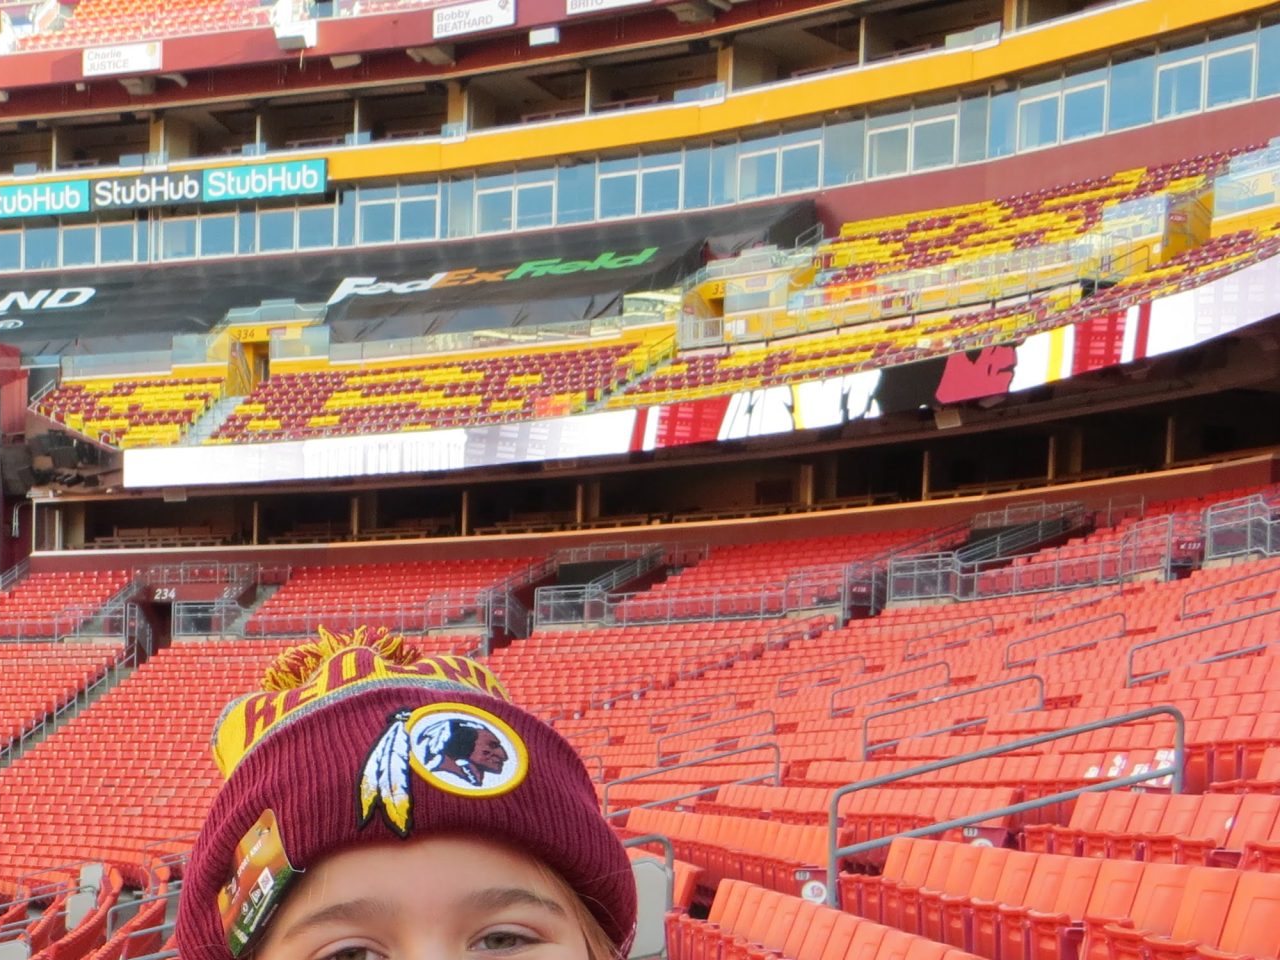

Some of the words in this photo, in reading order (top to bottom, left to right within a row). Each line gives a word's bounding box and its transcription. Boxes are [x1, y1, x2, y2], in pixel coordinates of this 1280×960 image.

[437, 9, 470, 23] Bobby
[437, 15, 494, 34] BEATHARD
[94, 175, 199, 206] StubHub
[207, 164, 319, 197] StubHub
[154, 587, 177, 600] 234
